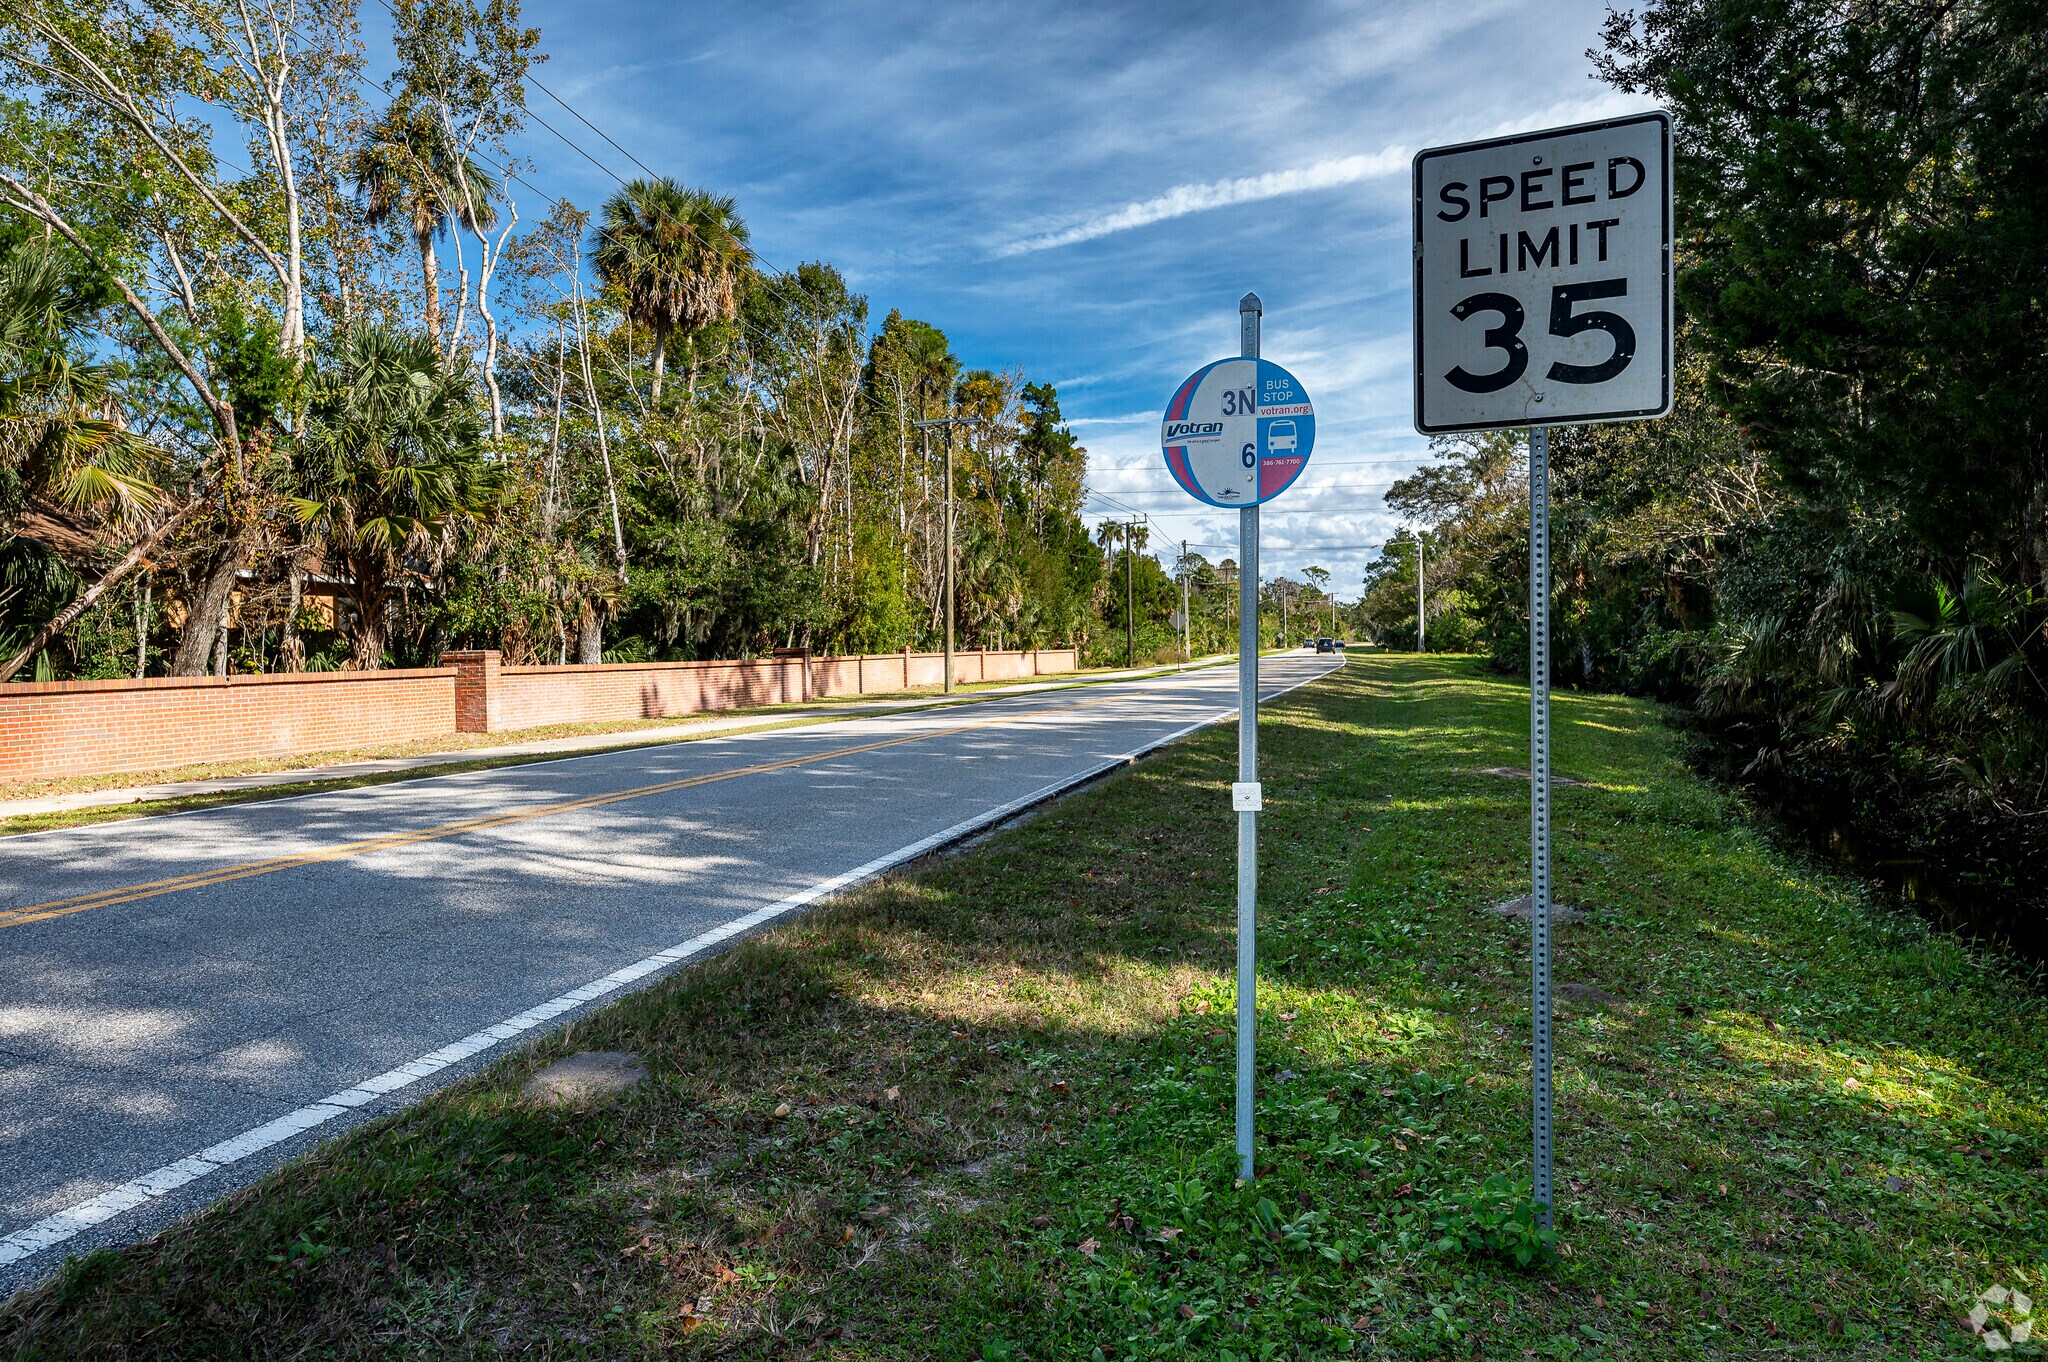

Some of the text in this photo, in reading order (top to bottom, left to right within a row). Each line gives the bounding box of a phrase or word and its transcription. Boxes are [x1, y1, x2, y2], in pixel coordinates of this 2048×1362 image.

[1436, 156, 1645, 223] SPEED
[1460, 218, 1620, 278] LIMIT
[1443, 278, 1636, 394] 35
[1263, 391, 1293, 402] STOP
[1266, 379, 1289, 390] BUS
[1222, 389, 1256, 416] 3N
[1260, 405, 1309, 416] votran.org
[1166, 422, 1224, 437] Votran
[1241, 443, 1256, 469] 6
